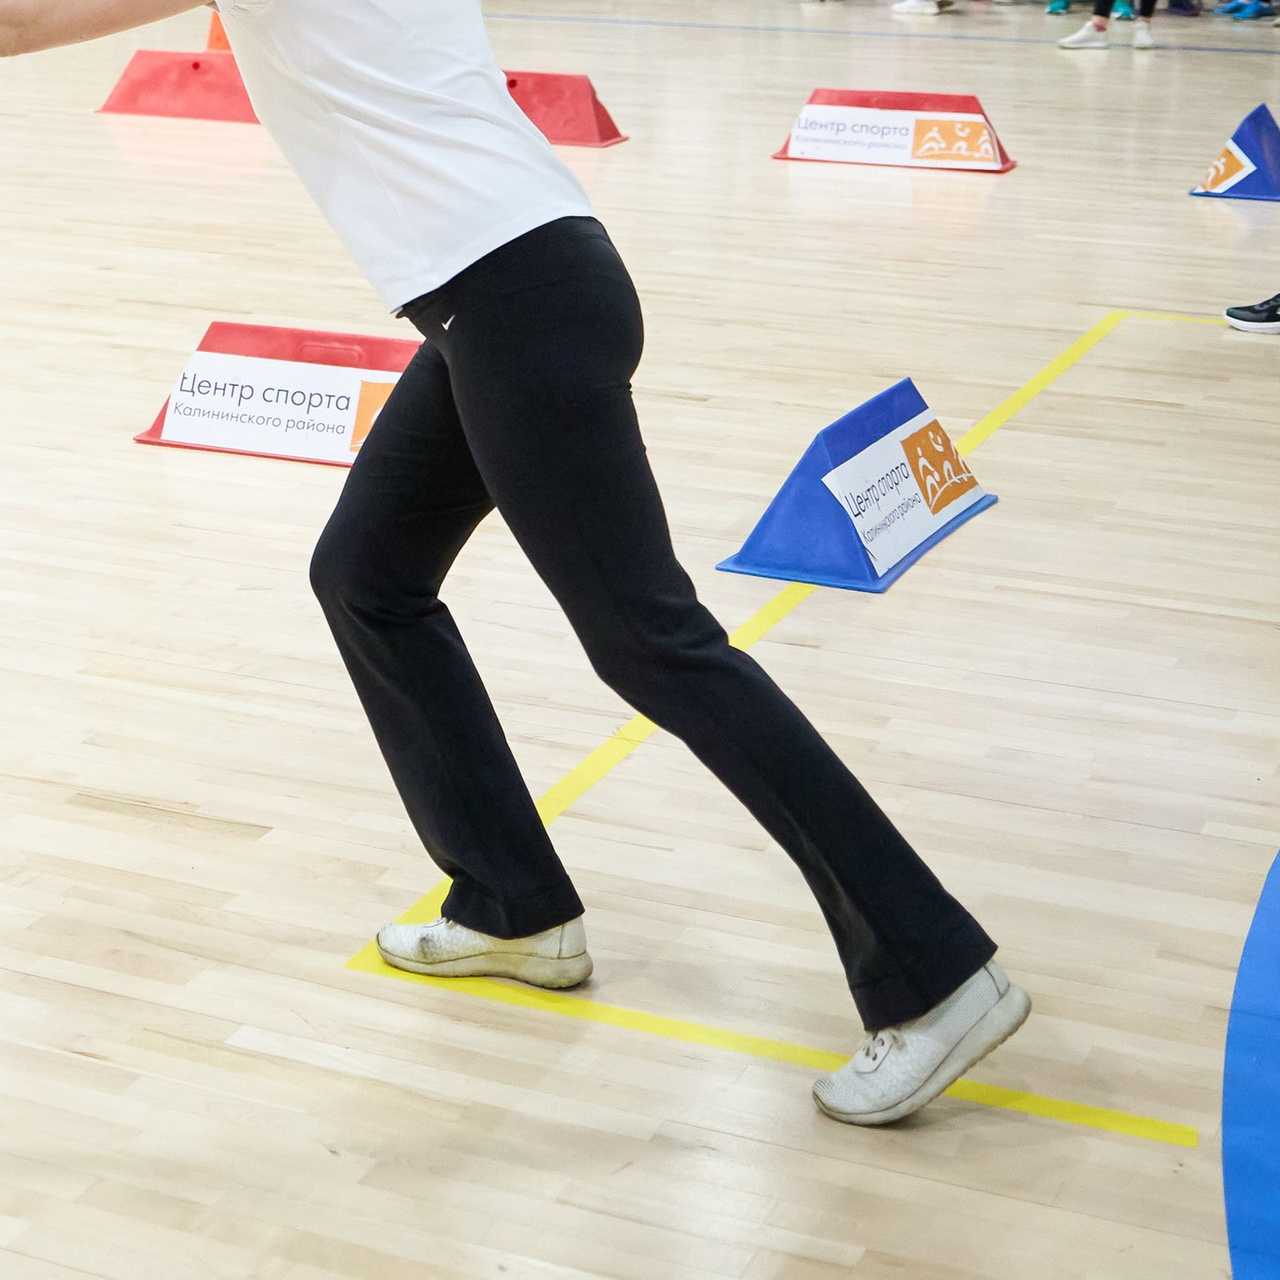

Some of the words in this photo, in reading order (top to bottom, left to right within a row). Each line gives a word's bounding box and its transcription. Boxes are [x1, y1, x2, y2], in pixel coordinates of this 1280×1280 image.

[797, 118, 847, 136] Центр
[851, 123, 910, 139] спорта
[179, 372, 255, 406] Центр
[262, 387, 351, 414] спорта
[173, 402, 282, 427] Калининского
[285, 418, 346, 434] района
[844, 484, 881, 519] Центр
[877, 462, 910, 496] спорта
